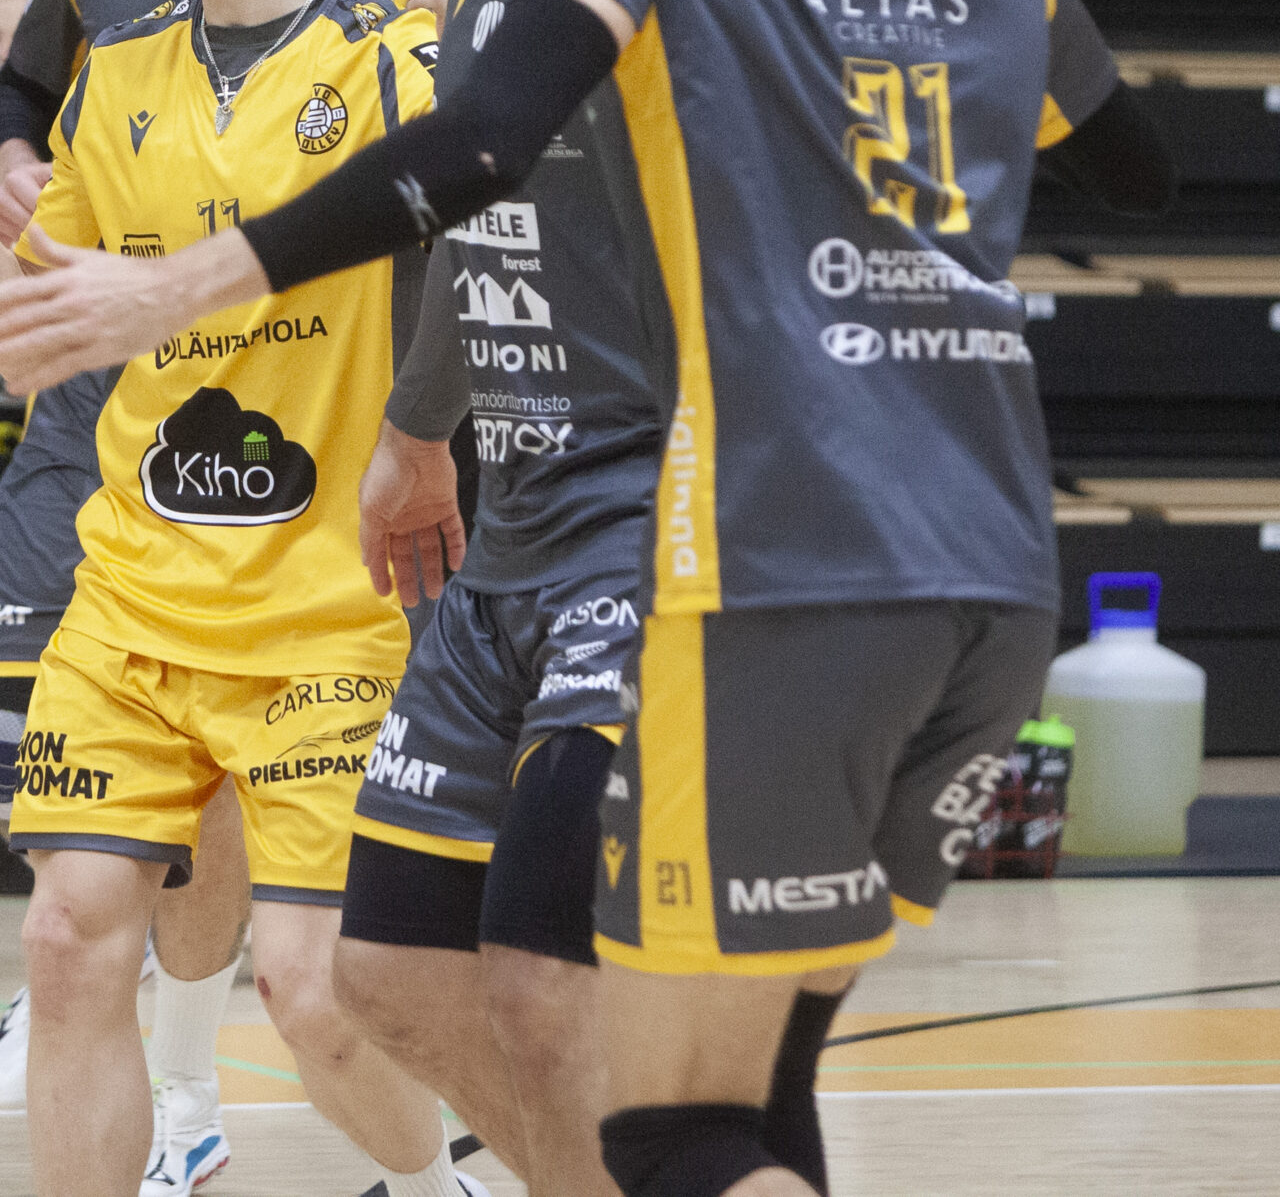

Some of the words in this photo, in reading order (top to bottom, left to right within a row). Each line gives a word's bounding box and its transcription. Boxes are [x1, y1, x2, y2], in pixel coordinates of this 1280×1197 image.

[841, 55, 971, 234] 21
[197, 198, 241, 239] 11
[501, 253, 542, 272] forest
[177, 315, 329, 360] LÄHITAPIOLA
[174, 451, 275, 499] Kiho
[249, 754, 366, 787] PIELISPAK
[656, 860, 693, 907] 21
